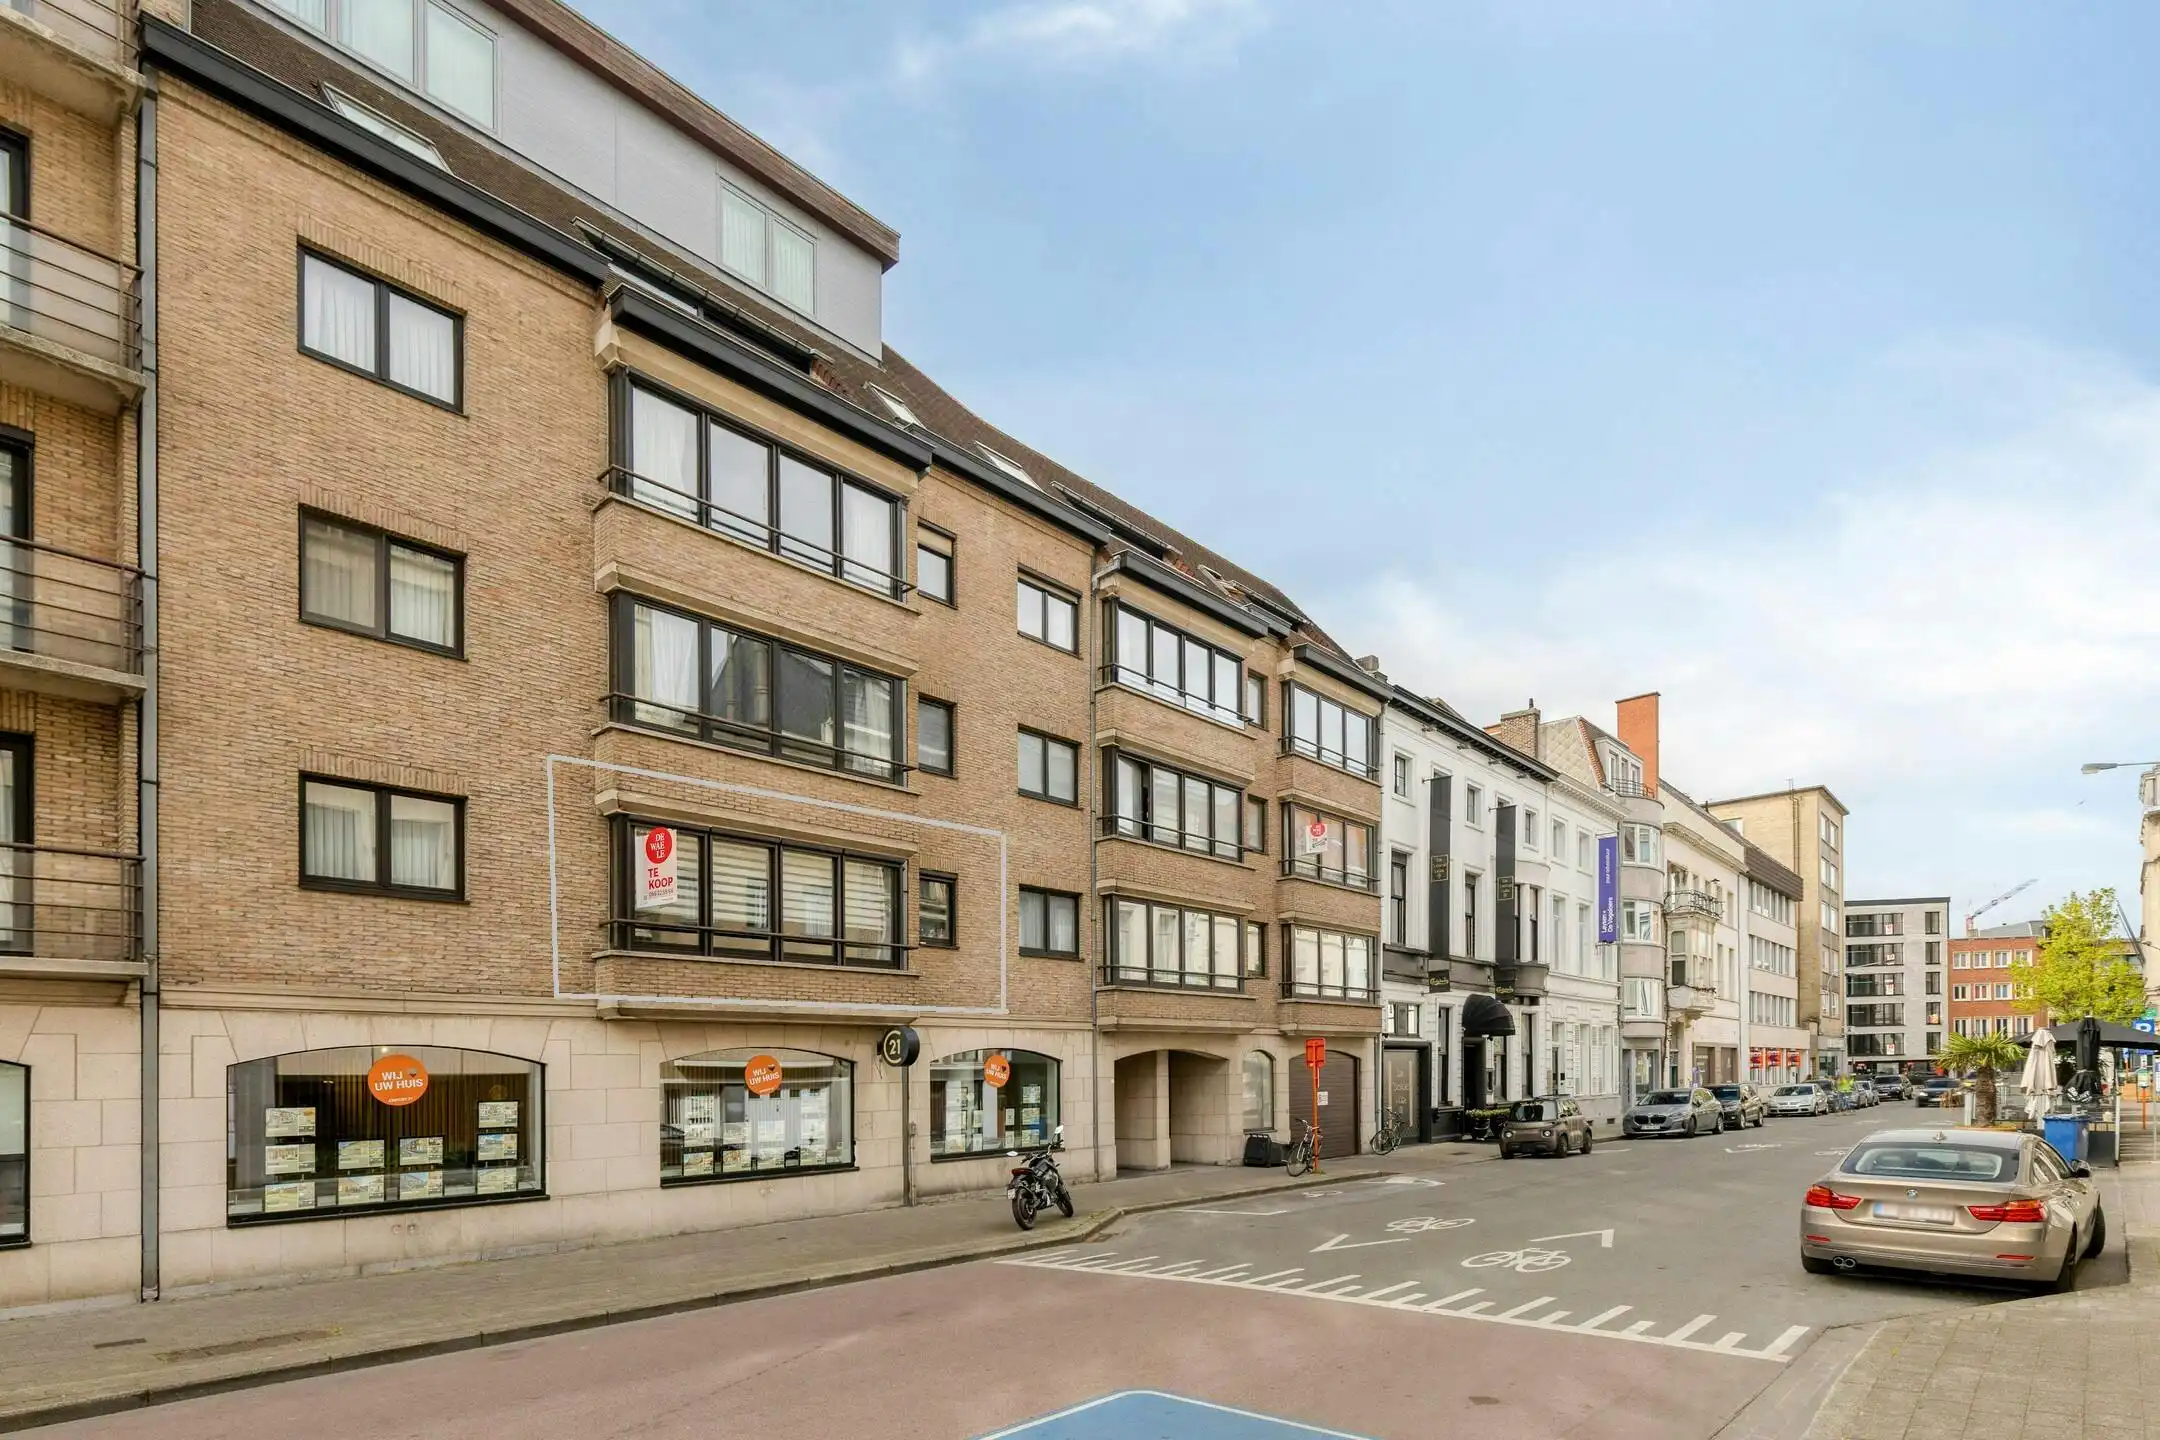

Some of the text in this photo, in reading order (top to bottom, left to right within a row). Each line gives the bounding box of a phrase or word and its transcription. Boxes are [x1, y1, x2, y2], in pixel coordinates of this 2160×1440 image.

[650, 841, 665, 851] WAE
[648, 868, 659, 878] TE
[648, 877, 673, 890] KOOP
[889, 1039, 901, 1055] 21
[381, 1071, 403, 1081] WIJ
[752, 1067, 767, 1077] WIJ
[749, 1071, 780, 1086] UW HUIS
[374, 1078, 424, 1091] UW HUIS
